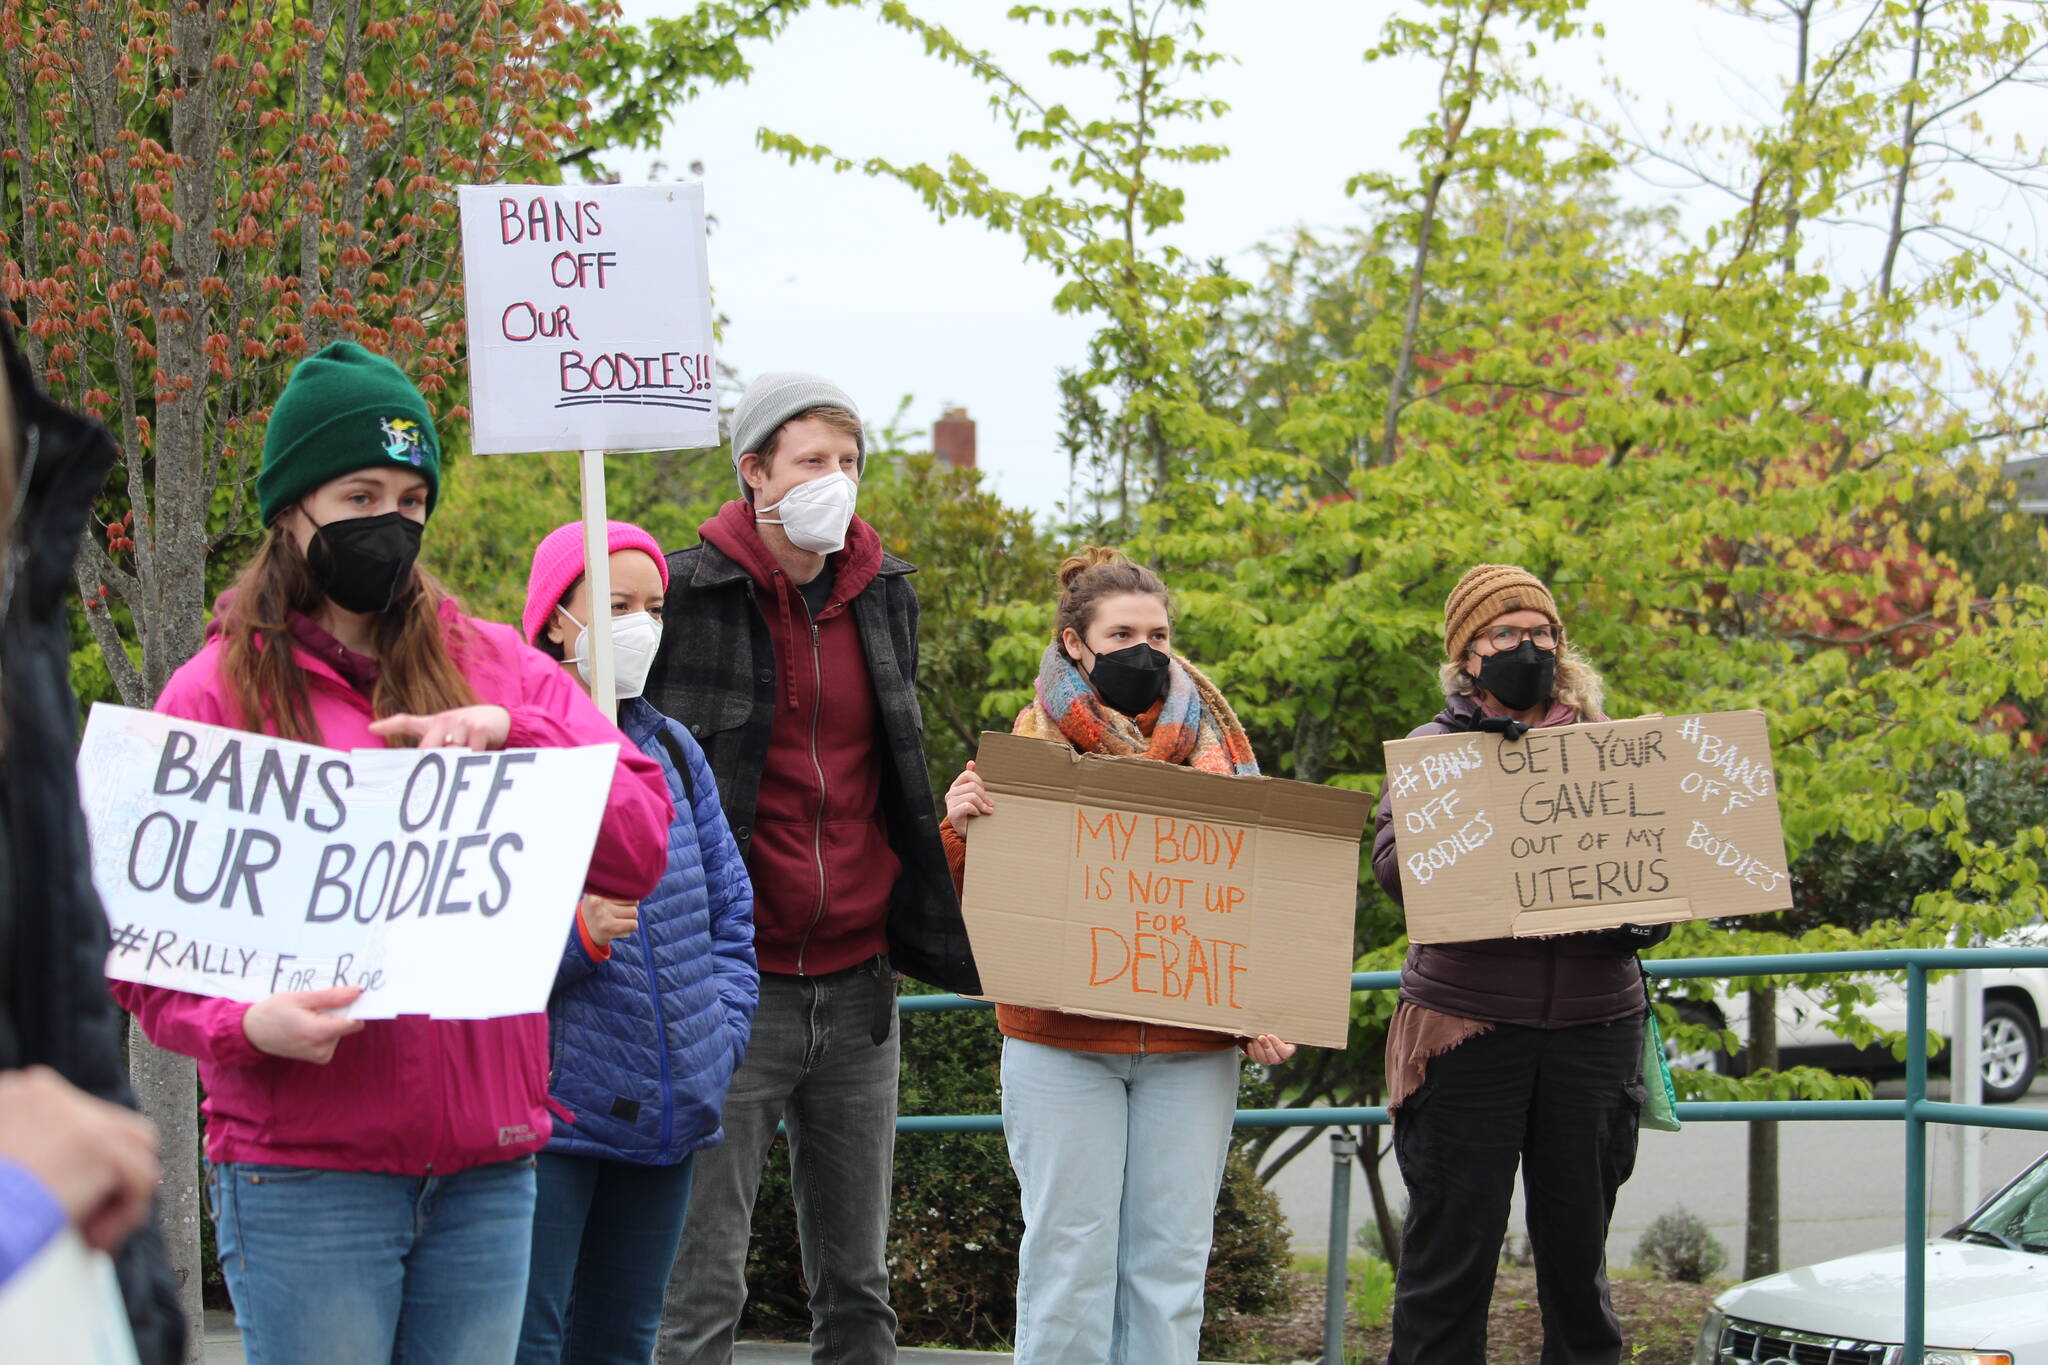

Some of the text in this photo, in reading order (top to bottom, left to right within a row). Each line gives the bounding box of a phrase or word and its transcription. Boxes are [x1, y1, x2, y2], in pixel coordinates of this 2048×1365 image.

[499, 196, 602, 245] BANS
[551, 250, 617, 289] OFF
[501, 301, 580, 342] OUR
[560, 349, 712, 394] BODIES!!
[1497, 728, 1667, 774] GET YOUR
[153, 730, 537, 834] BANS OFF
[1520, 780, 1666, 825] GAVEL
[1679, 771, 1755, 815] OFF
[1405, 789, 1460, 834] OFF
[1075, 808, 1245, 870] MY BODY
[1406, 809, 1494, 885] BODIES
[1510, 827, 1666, 859] OUT OF MY
[1685, 820, 1785, 892] BODIES
[127, 810, 524, 924] OUR BODIES
[1084, 866, 1245, 914] IS NOT UP
[1514, 858, 1669, 908] UTERUS
[1135, 910, 1191, 936] FOR
[110, 924, 257, 979] #RALLY
[1089, 926, 1248, 1010] DEBATE
